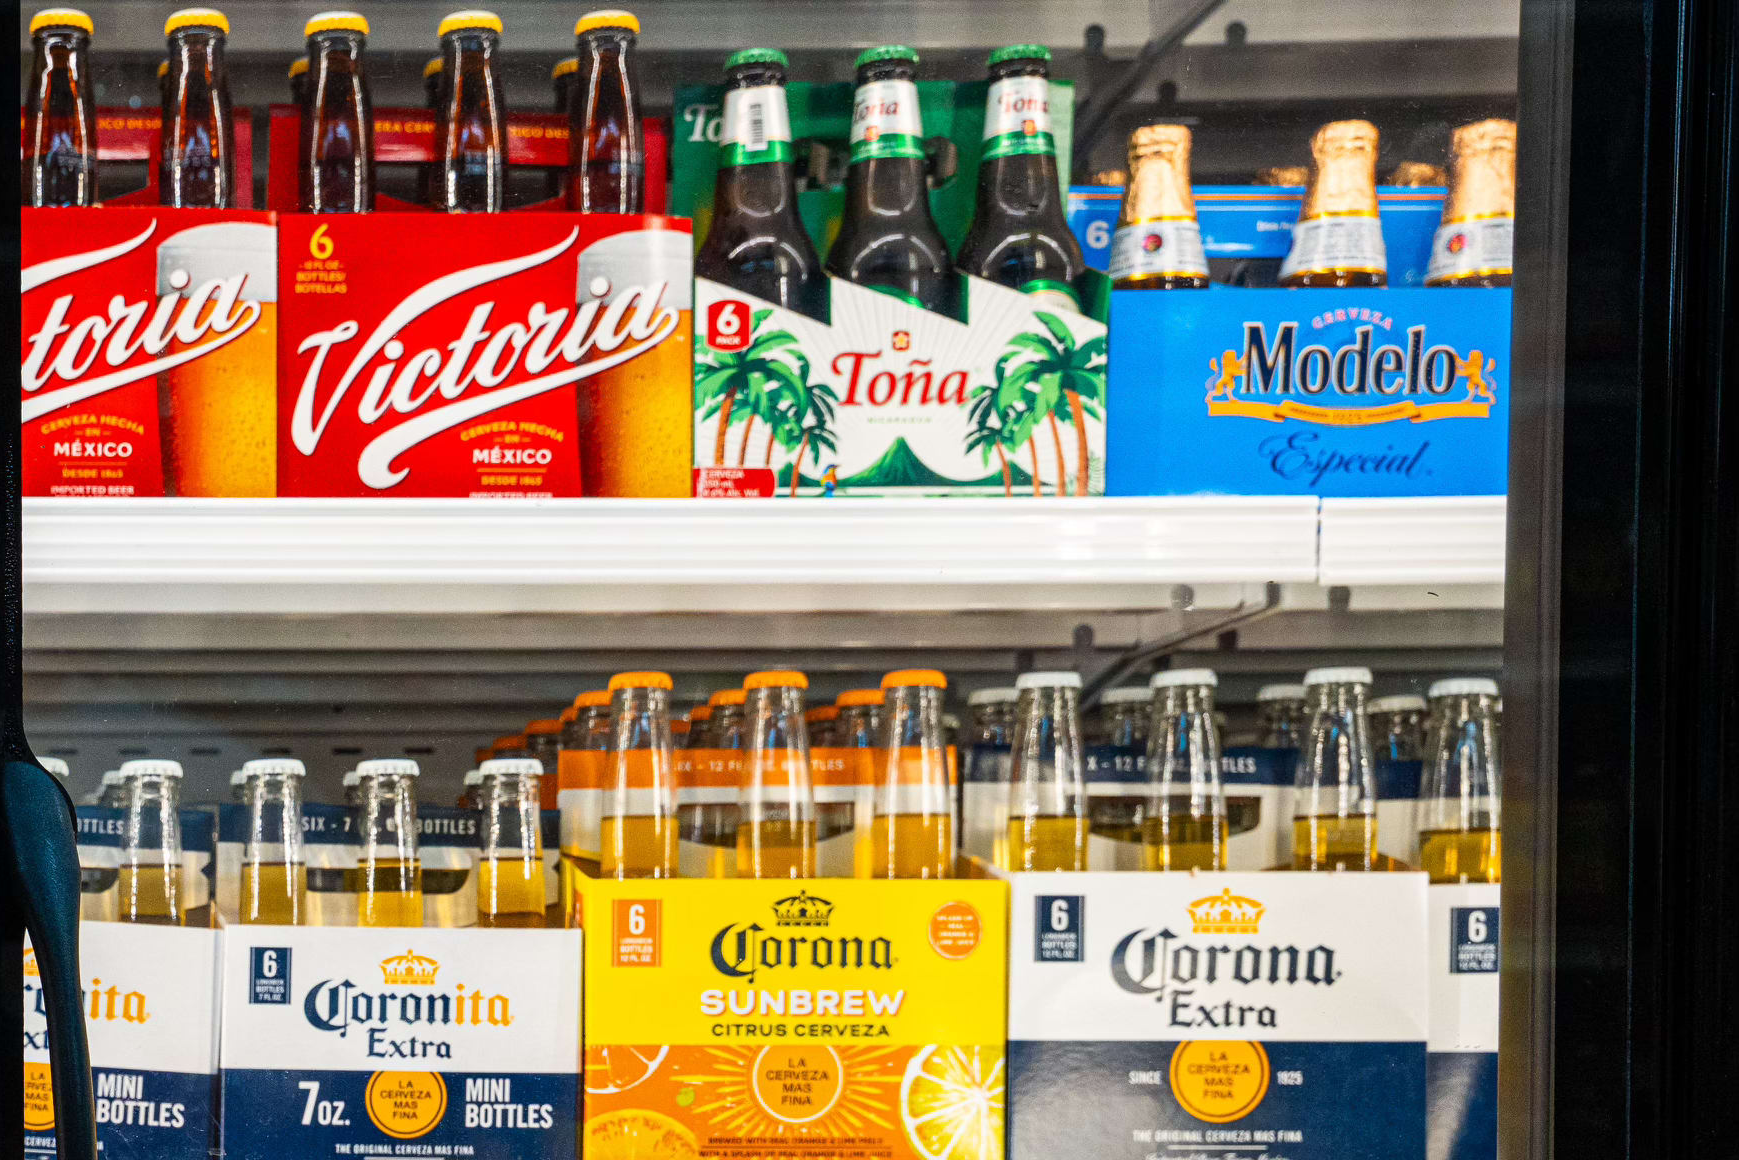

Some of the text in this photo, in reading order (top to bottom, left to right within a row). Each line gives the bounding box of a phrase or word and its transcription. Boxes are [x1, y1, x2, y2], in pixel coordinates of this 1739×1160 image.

[310, 224, 334, 259] 6
[716, 300, 740, 335] 6
[292, 226, 679, 490] Victoria
[1241, 320, 1457, 394] Modelo
[831, 350, 969, 407] Toña
[54, 440, 132, 457] MÉXICO
[473, 447, 551, 464] MÉXICO
[1259, 430, 1430, 487] Especial
[629, 904, 645, 934] 6
[1051, 900, 1069, 931] 6
[1467, 911, 1487, 942] 6
[263, 950, 277, 977] 6
[710, 922, 894, 983] Corona
[1110, 927, 1338, 1002] Corona
[304, 980, 512, 1037] Coronita
[700, 989, 906, 1017] SUNBREW
[1168, 990, 1277, 1028] Extra
[367, 1028, 452, 1059] Extra
[711, 1024, 890, 1038] CITRUS CERVEZA
[766, 1070, 829, 1080] CERVEZA
[788, 1059, 806, 1068] LA
[98, 1073, 144, 1098] MINI
[398, 1080, 413, 1090] LA
[466, 1079, 510, 1103] MINI
[782, 1083, 812, 1093] MAS
[1129, 1072, 1161, 1085] SINCE
[380, 1090, 432, 1100] CERVEZA
[394, 1101, 418, 1110] MAS
[781, 1096, 812, 1106] FINA
[97, 1101, 185, 1127] BOTTLES
[392, 1111, 418, 1120] FINA
[465, 1104, 553, 1129] BOTTLES
